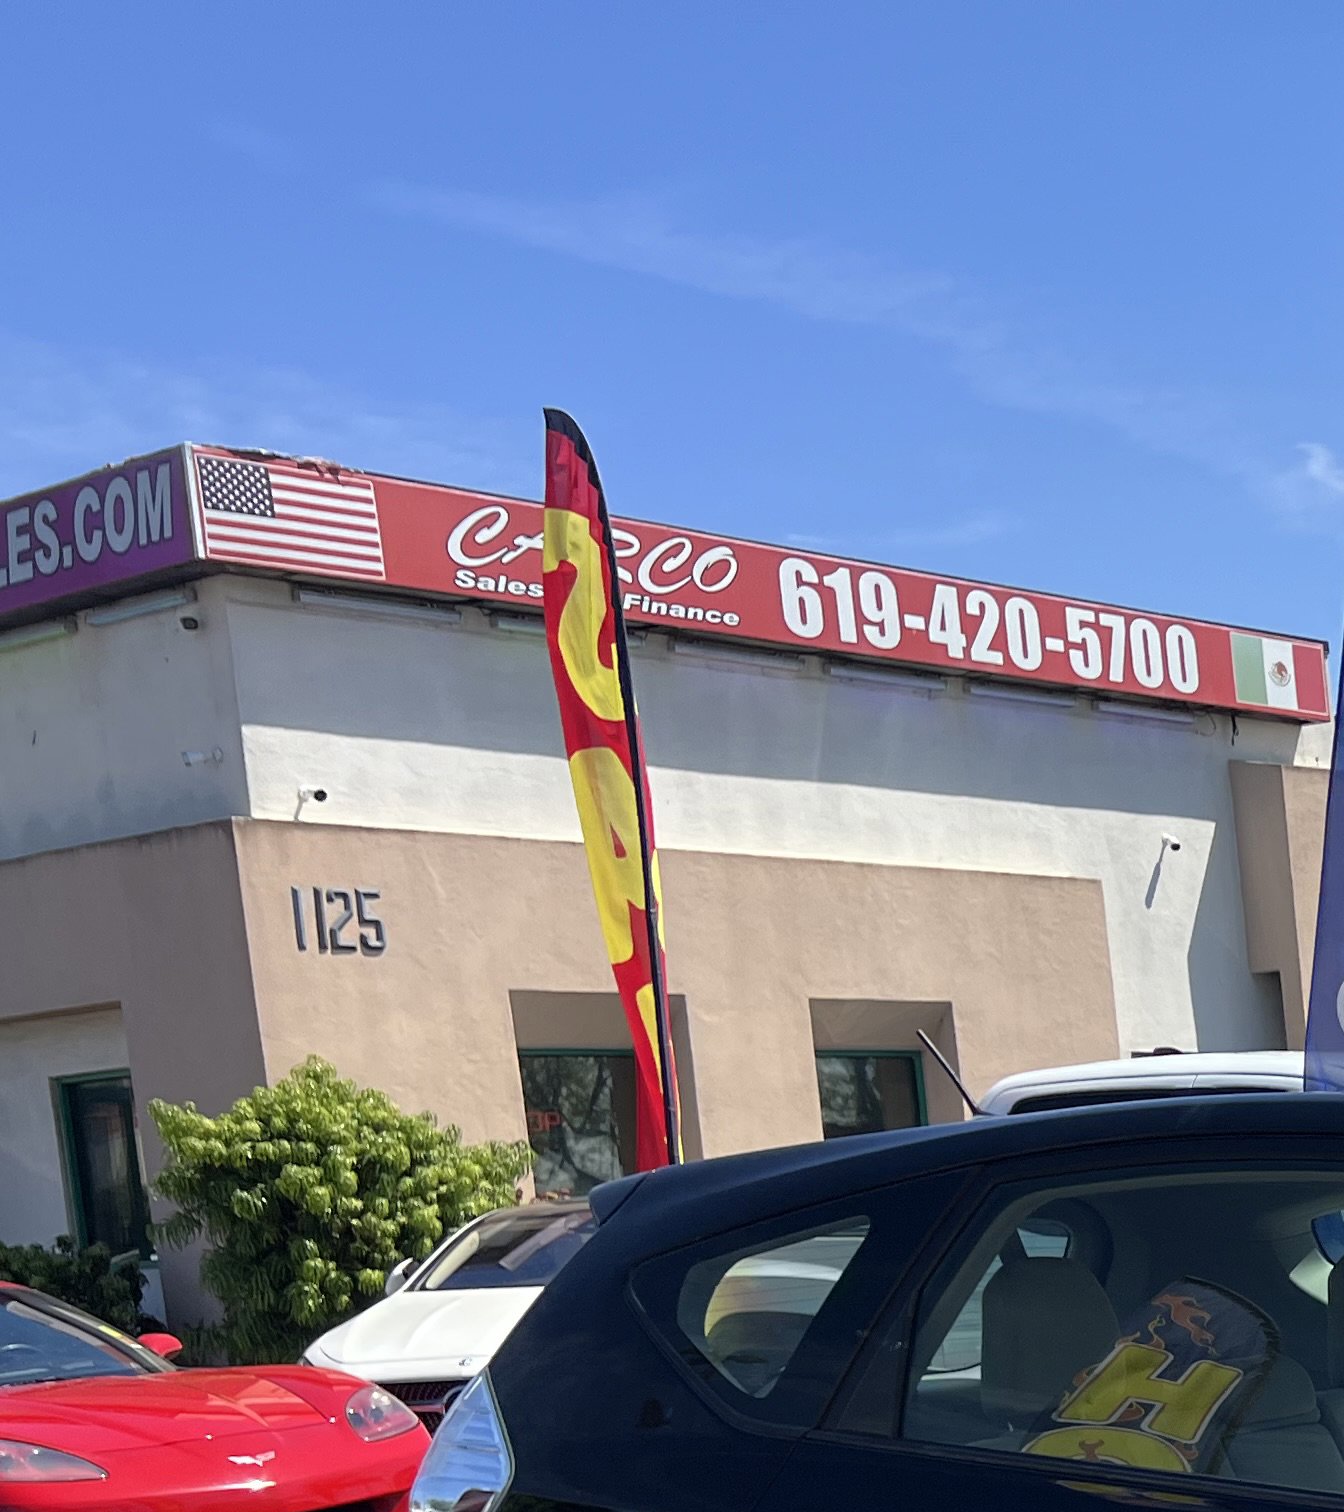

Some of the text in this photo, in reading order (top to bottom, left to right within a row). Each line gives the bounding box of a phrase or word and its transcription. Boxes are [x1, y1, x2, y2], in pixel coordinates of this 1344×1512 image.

[453, 567, 741, 627] Sales Finance
[778, 557, 1199, 694] 619-420-5700
[290, 886, 387, 957] 1125
